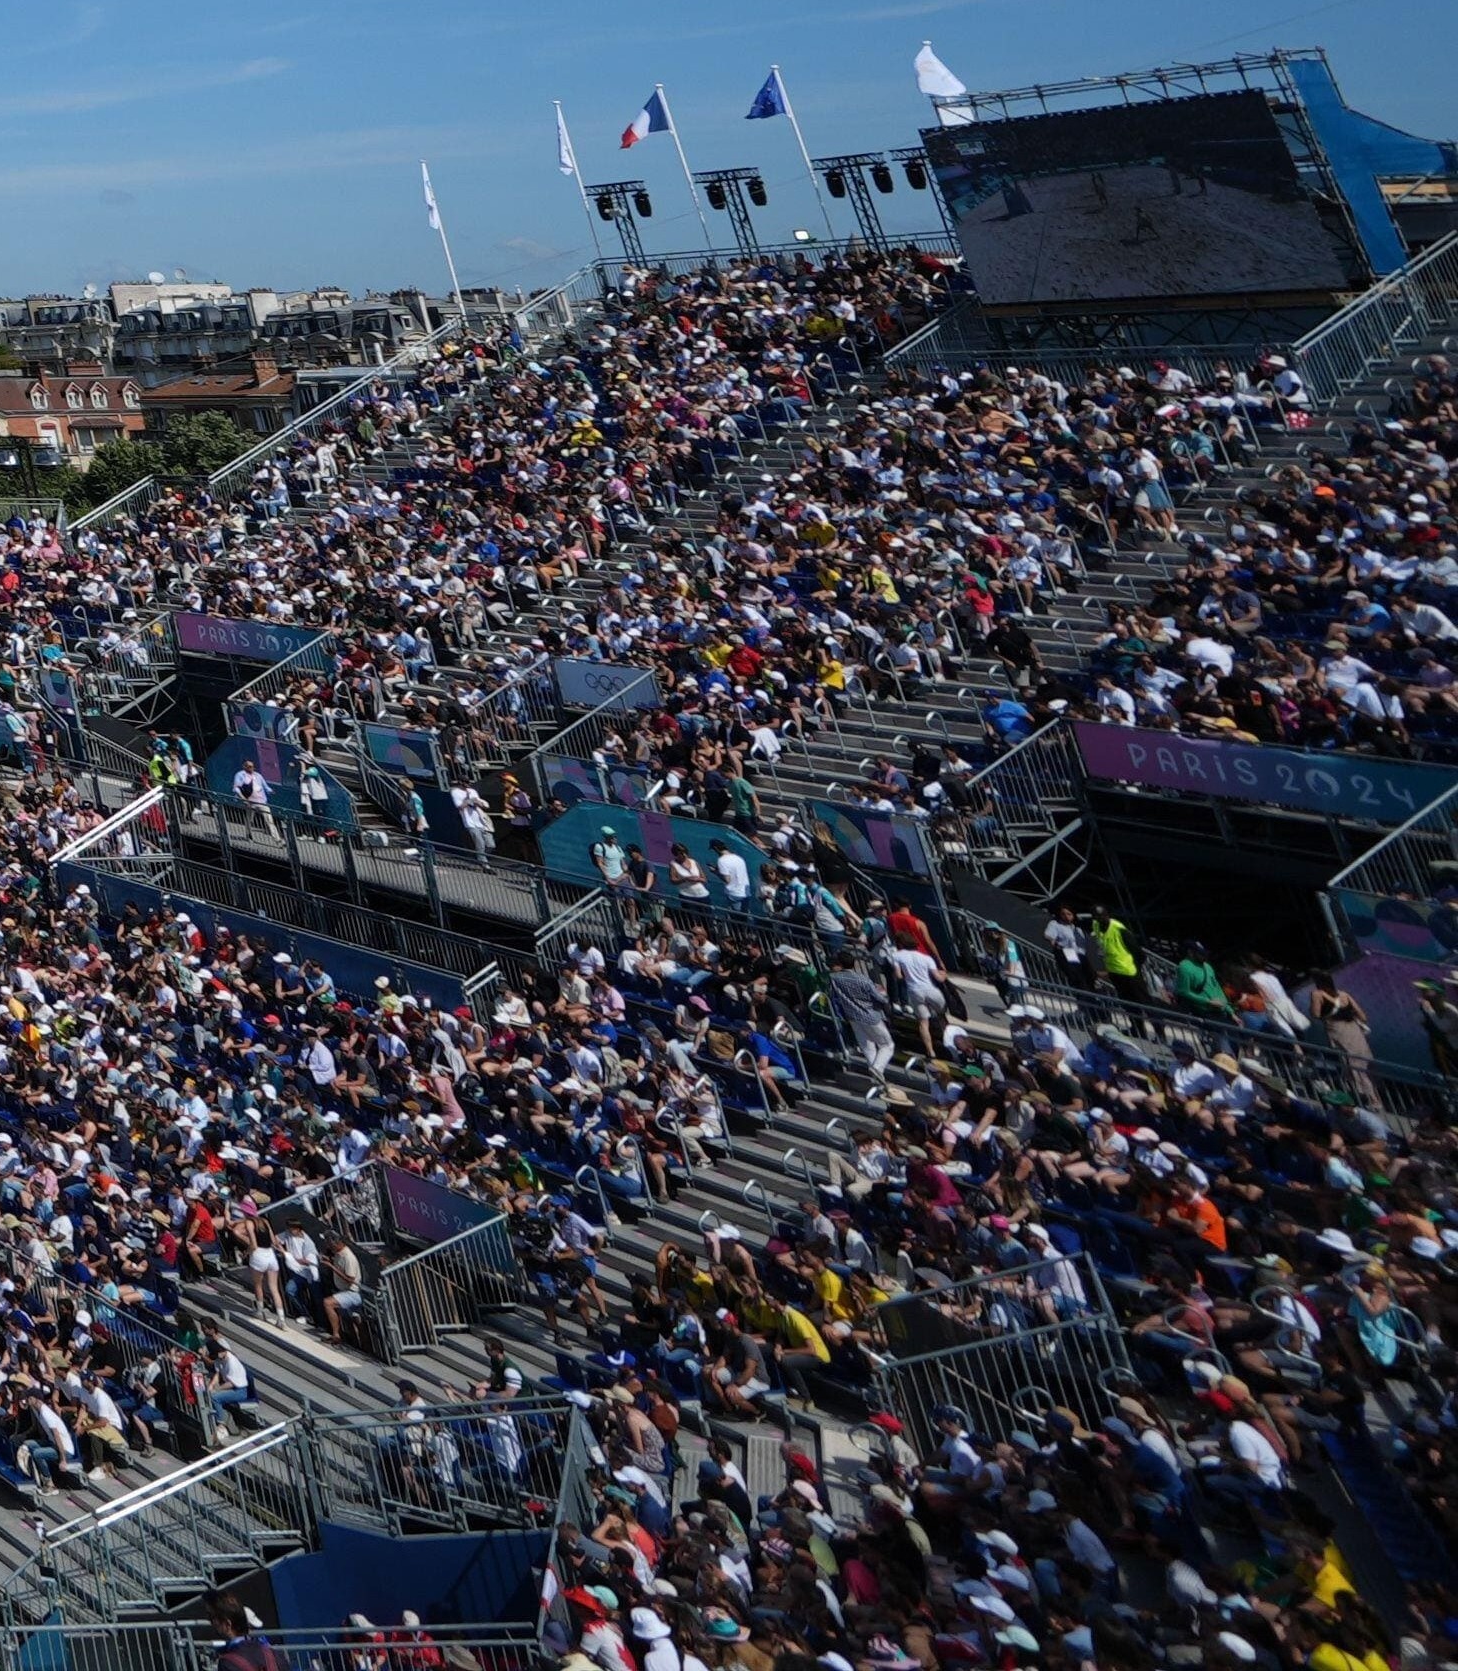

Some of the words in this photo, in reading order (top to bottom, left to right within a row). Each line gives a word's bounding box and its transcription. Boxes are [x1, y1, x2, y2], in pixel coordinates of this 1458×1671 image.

[197, 625, 250, 647] PARIS
[1126, 743, 1258, 786] PARIS
[1276, 765, 1415, 810] 2024
